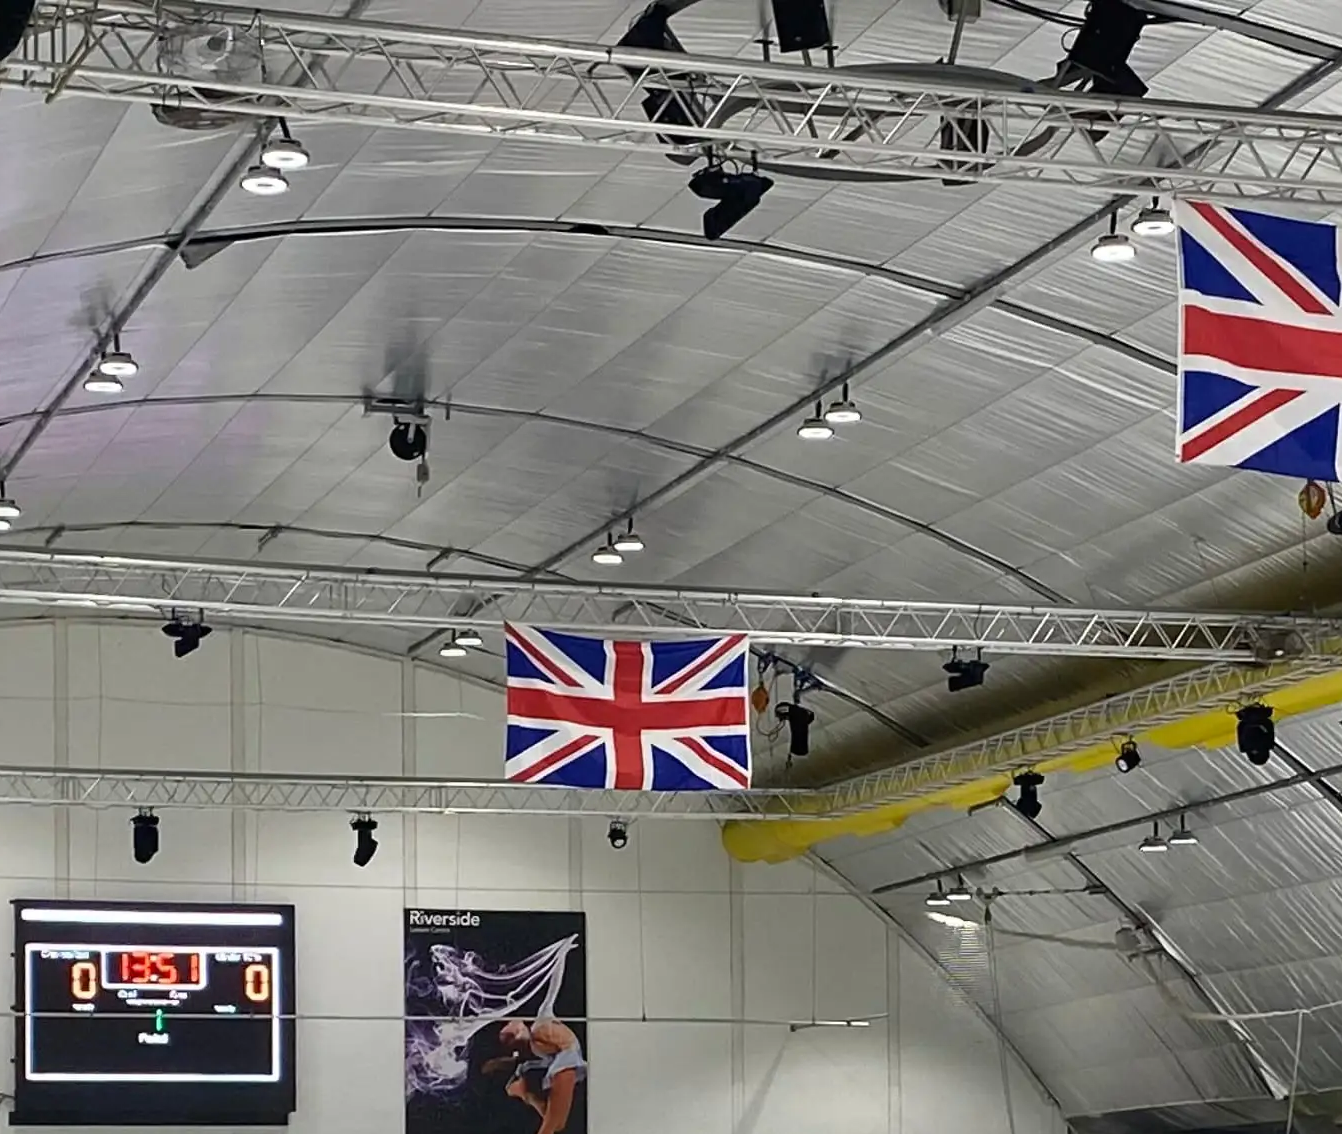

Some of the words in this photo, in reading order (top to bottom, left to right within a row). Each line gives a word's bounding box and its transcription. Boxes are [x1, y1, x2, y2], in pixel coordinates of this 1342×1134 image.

[410, 910, 480, 927] Riverside
[72, 962, 97, 1000] 0
[121, 951, 199, 983] 13:51
[245, 963, 270, 1001] 0
